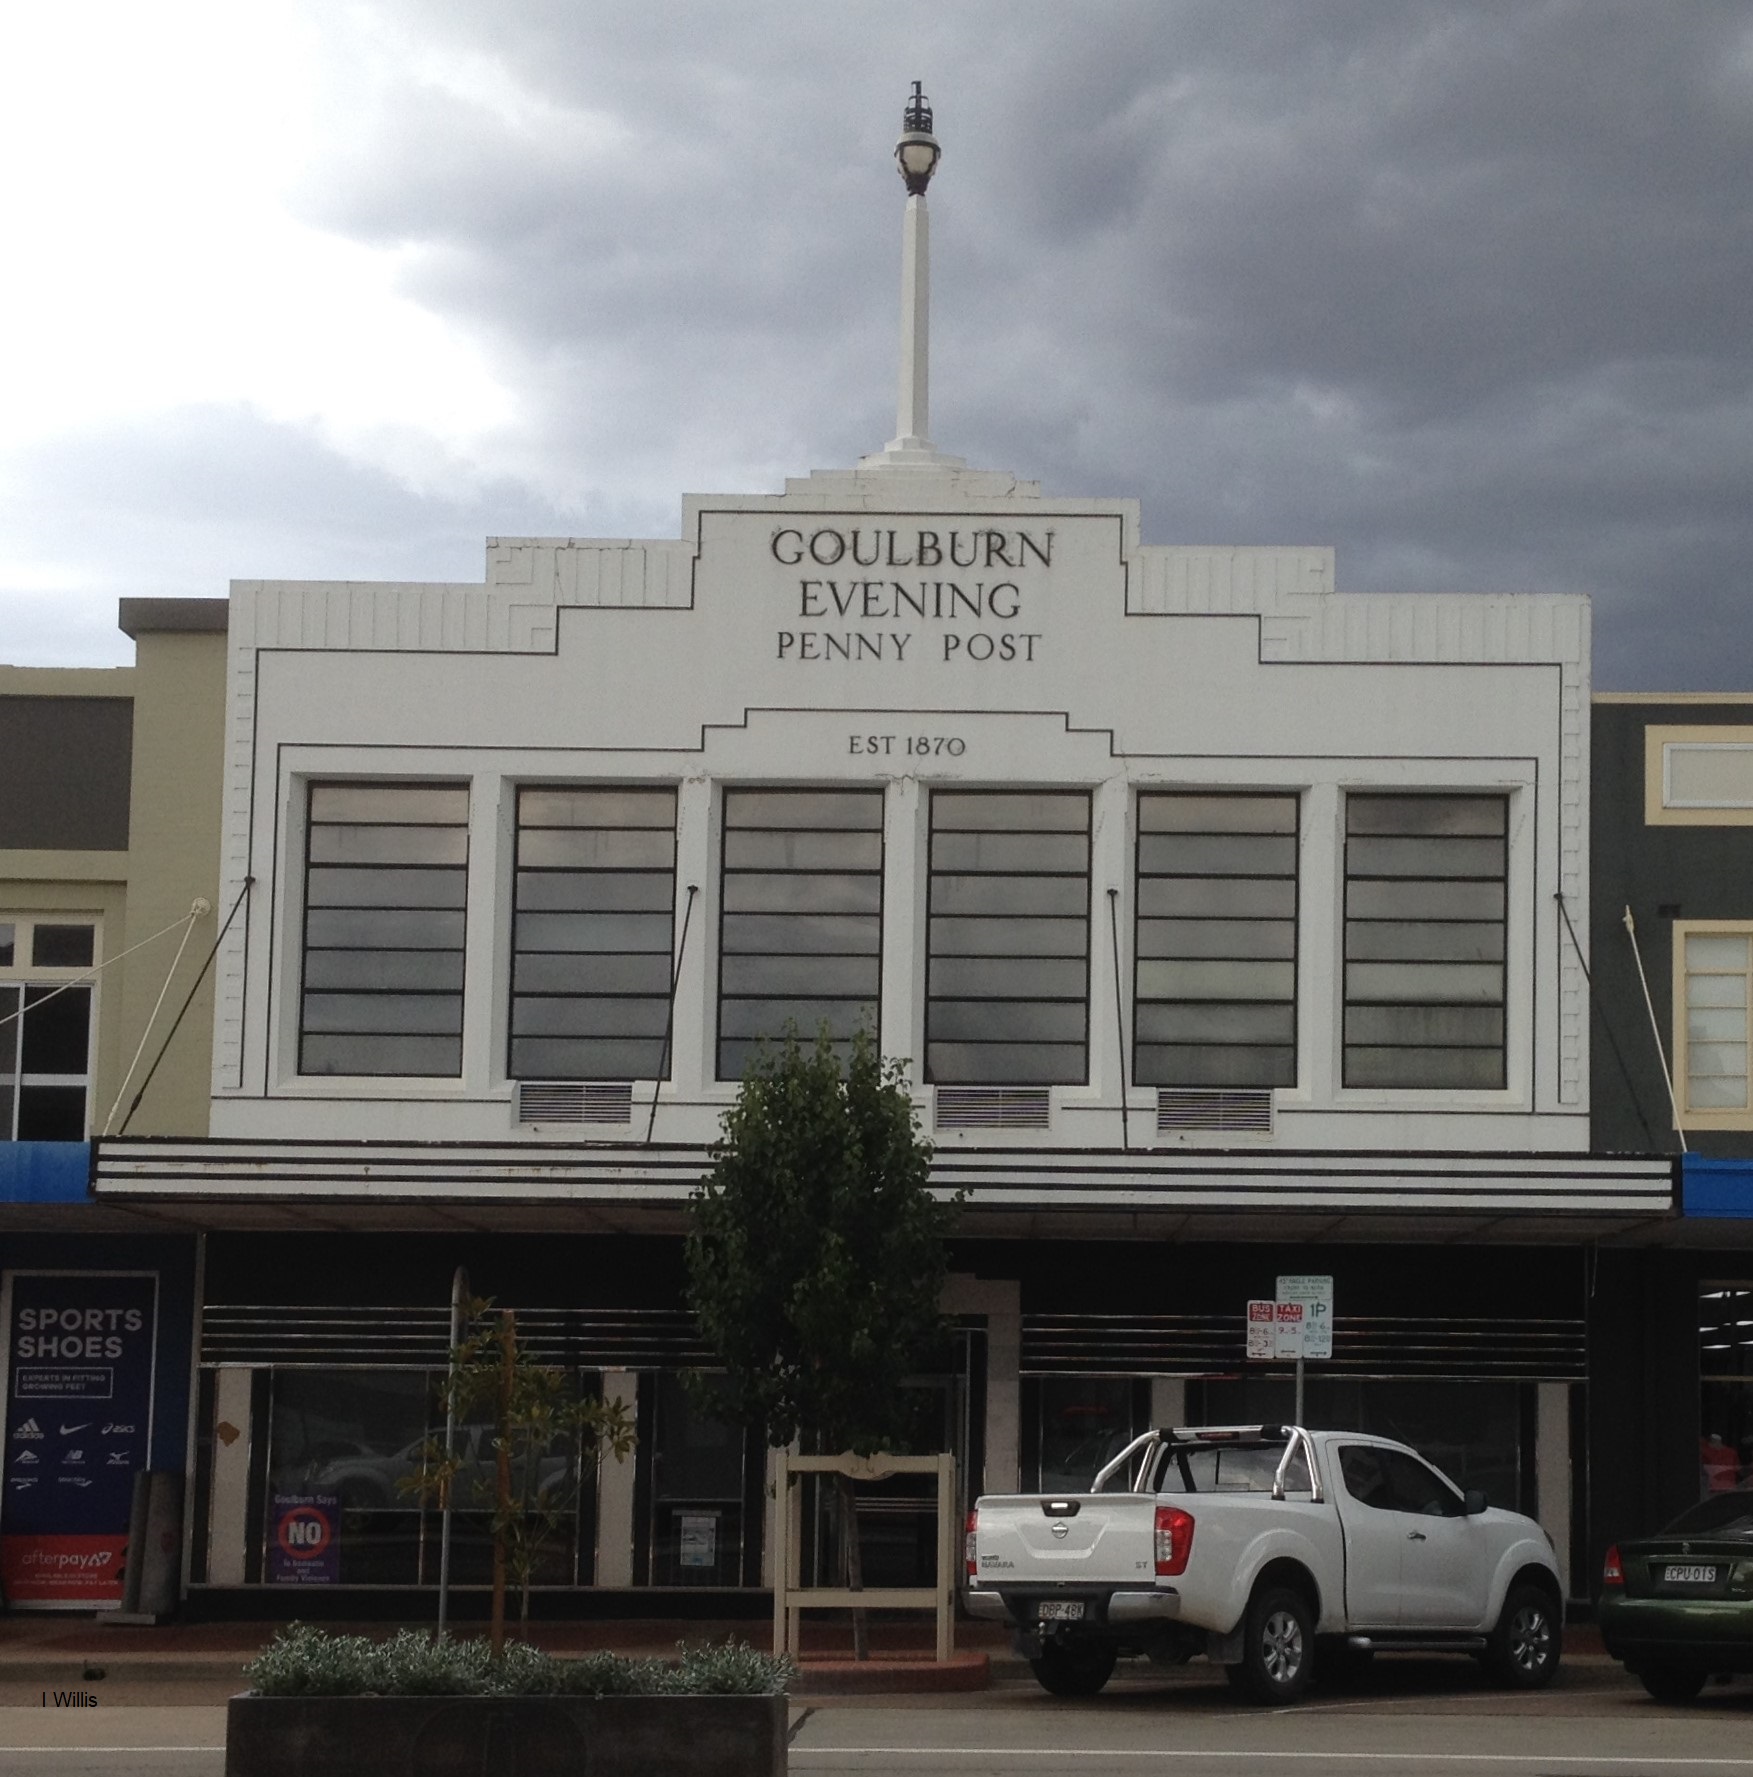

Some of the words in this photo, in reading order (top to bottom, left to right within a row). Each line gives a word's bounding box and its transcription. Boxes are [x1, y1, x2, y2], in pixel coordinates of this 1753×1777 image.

[770, 529, 1055, 567] GOULBURN
[799, 580, 1021, 619] EVENING
[776, 631, 911, 661] PENNY
[943, 633, 1042, 661] POST
[849, 736, 896, 755] EST
[906, 736, 966, 757] 1870
[18, 1308, 143, 1331] SPORTS
[1310, 1303, 1326, 1318] 1P
[17, 1335, 123, 1358] SHOES
[288, 1521, 322, 1545] NO
[22, 1550, 89, 1570] afterpay
